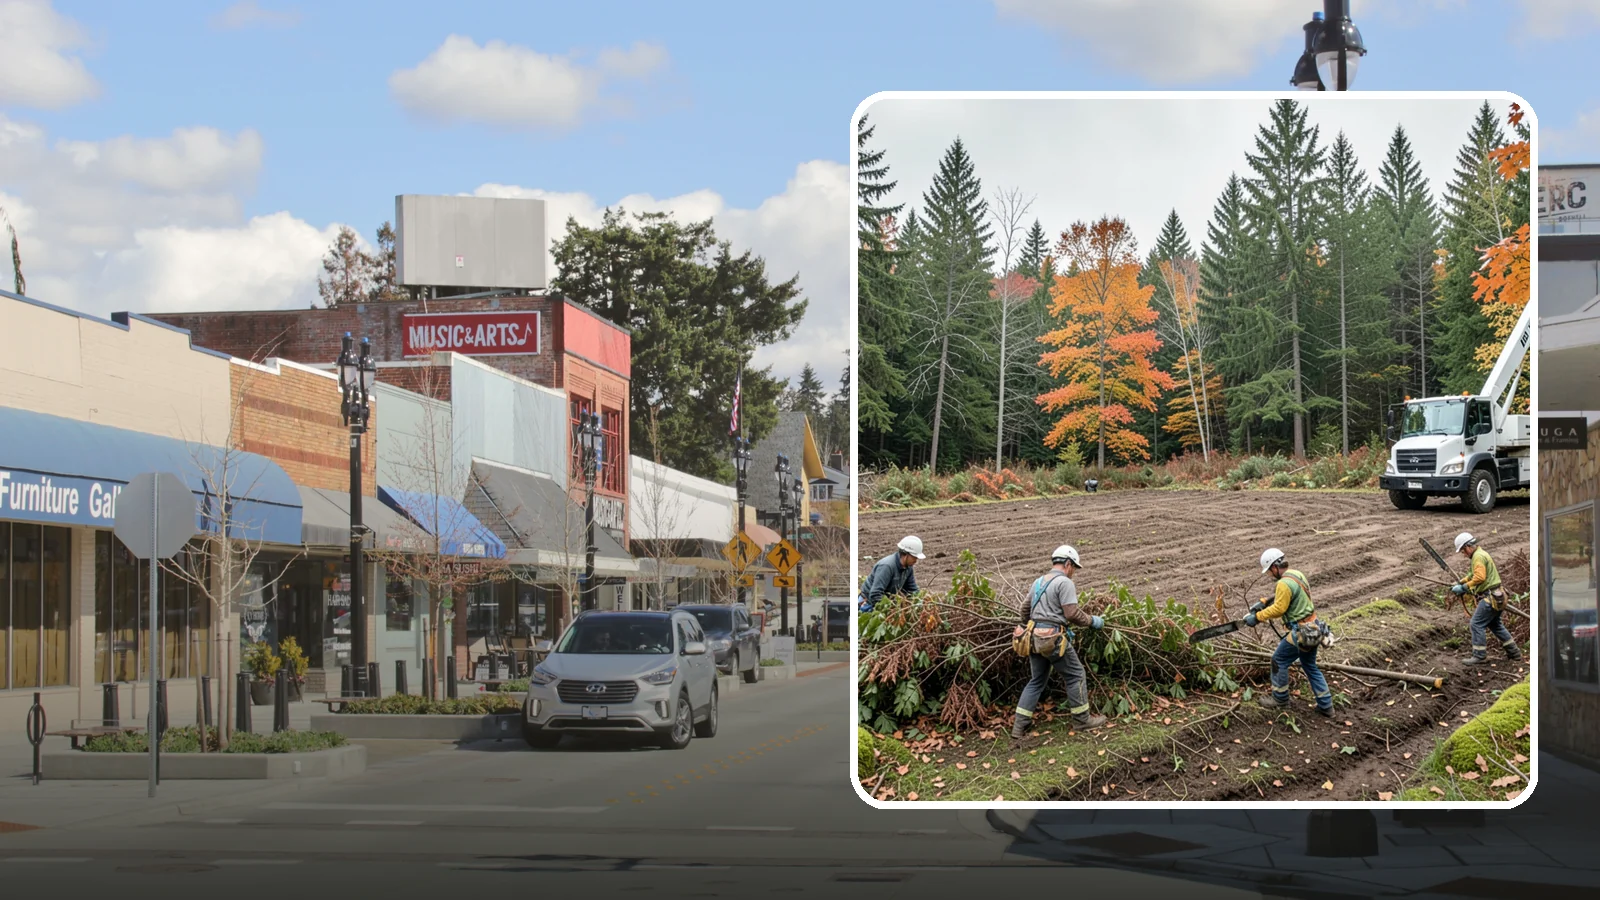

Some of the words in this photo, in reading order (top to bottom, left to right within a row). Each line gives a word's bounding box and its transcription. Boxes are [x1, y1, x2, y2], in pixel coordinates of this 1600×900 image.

[409, 323, 519, 348] MUSIC&ARTS
[1540, 427, 1577, 436] UGA
[0, 472, 79, 515] Furniture
